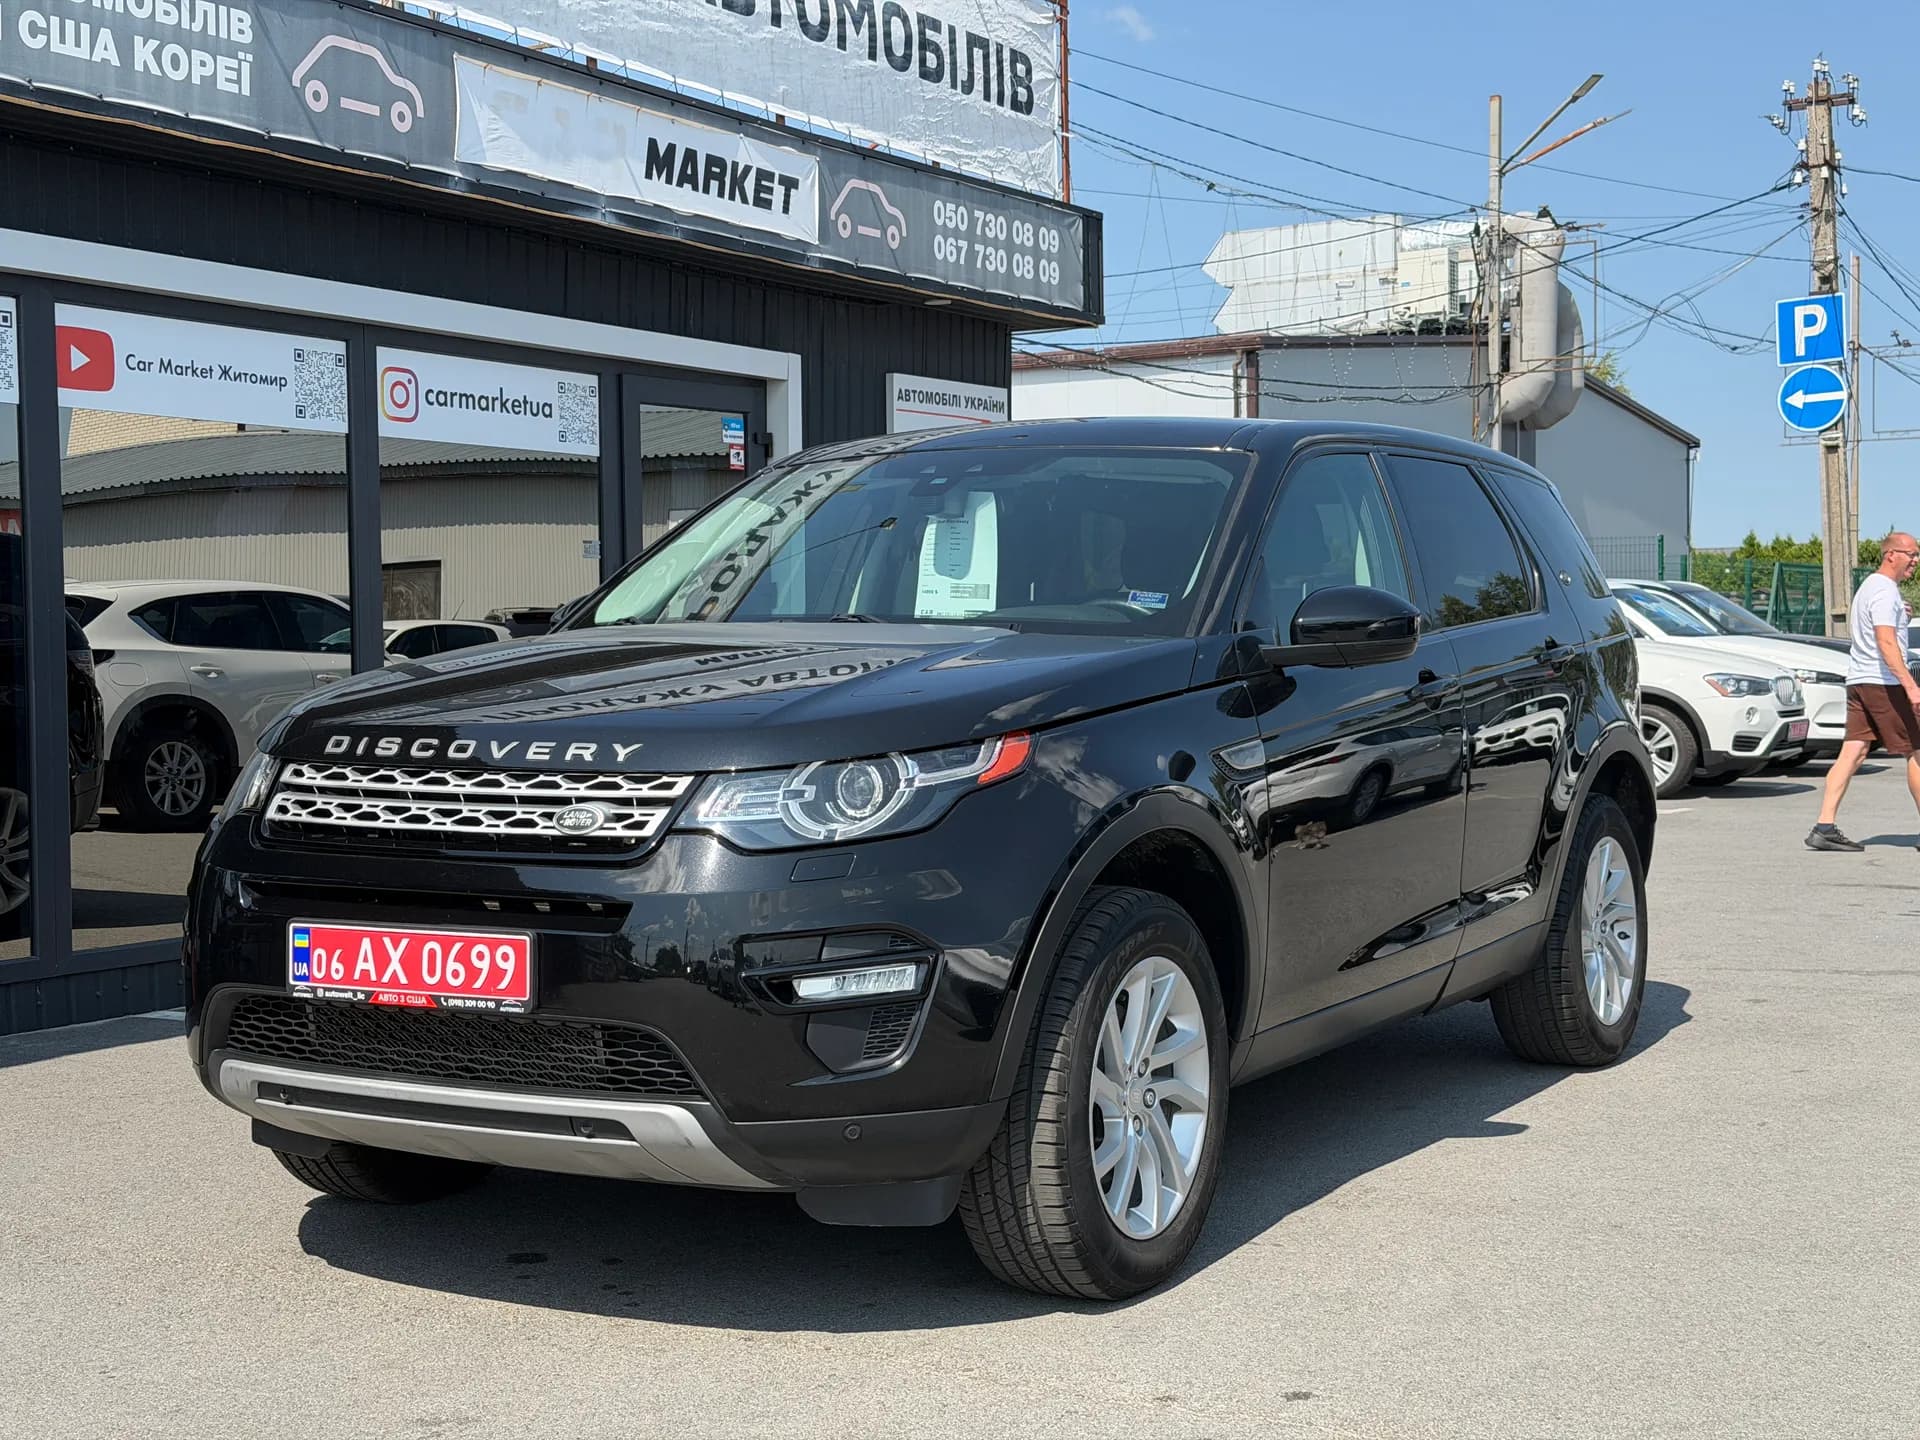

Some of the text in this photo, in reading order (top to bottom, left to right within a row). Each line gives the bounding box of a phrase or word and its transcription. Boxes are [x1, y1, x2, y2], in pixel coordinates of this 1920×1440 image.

[18, 9, 120, 67] США
[134, 35, 253, 97] КОРЕЇ
[644, 137, 800, 215] MARKET
[933, 200, 1059, 253] 050 730 08 09
[933, 234, 1060, 286] 067 730 08 09
[1794, 304, 1827, 357] P
[125, 354, 288, 392] Car Market Житомир
[425, 386, 553, 419] carmarketua
[897, 387, 1005, 414] АВТОМОБІЛІ УКРАЇНИ
[324, 735, 643, 762] DISCOVERY
[563, 811, 588, 819] LAND
[563, 818, 593, 827] ROVER
[294, 962, 309, 976] UA
[312, 937, 516, 990] 06 AX 0699
[378, 993, 398, 1003] АВТО
[407, 994, 427, 1005] США
[477, 1000, 486, 1008] 00
